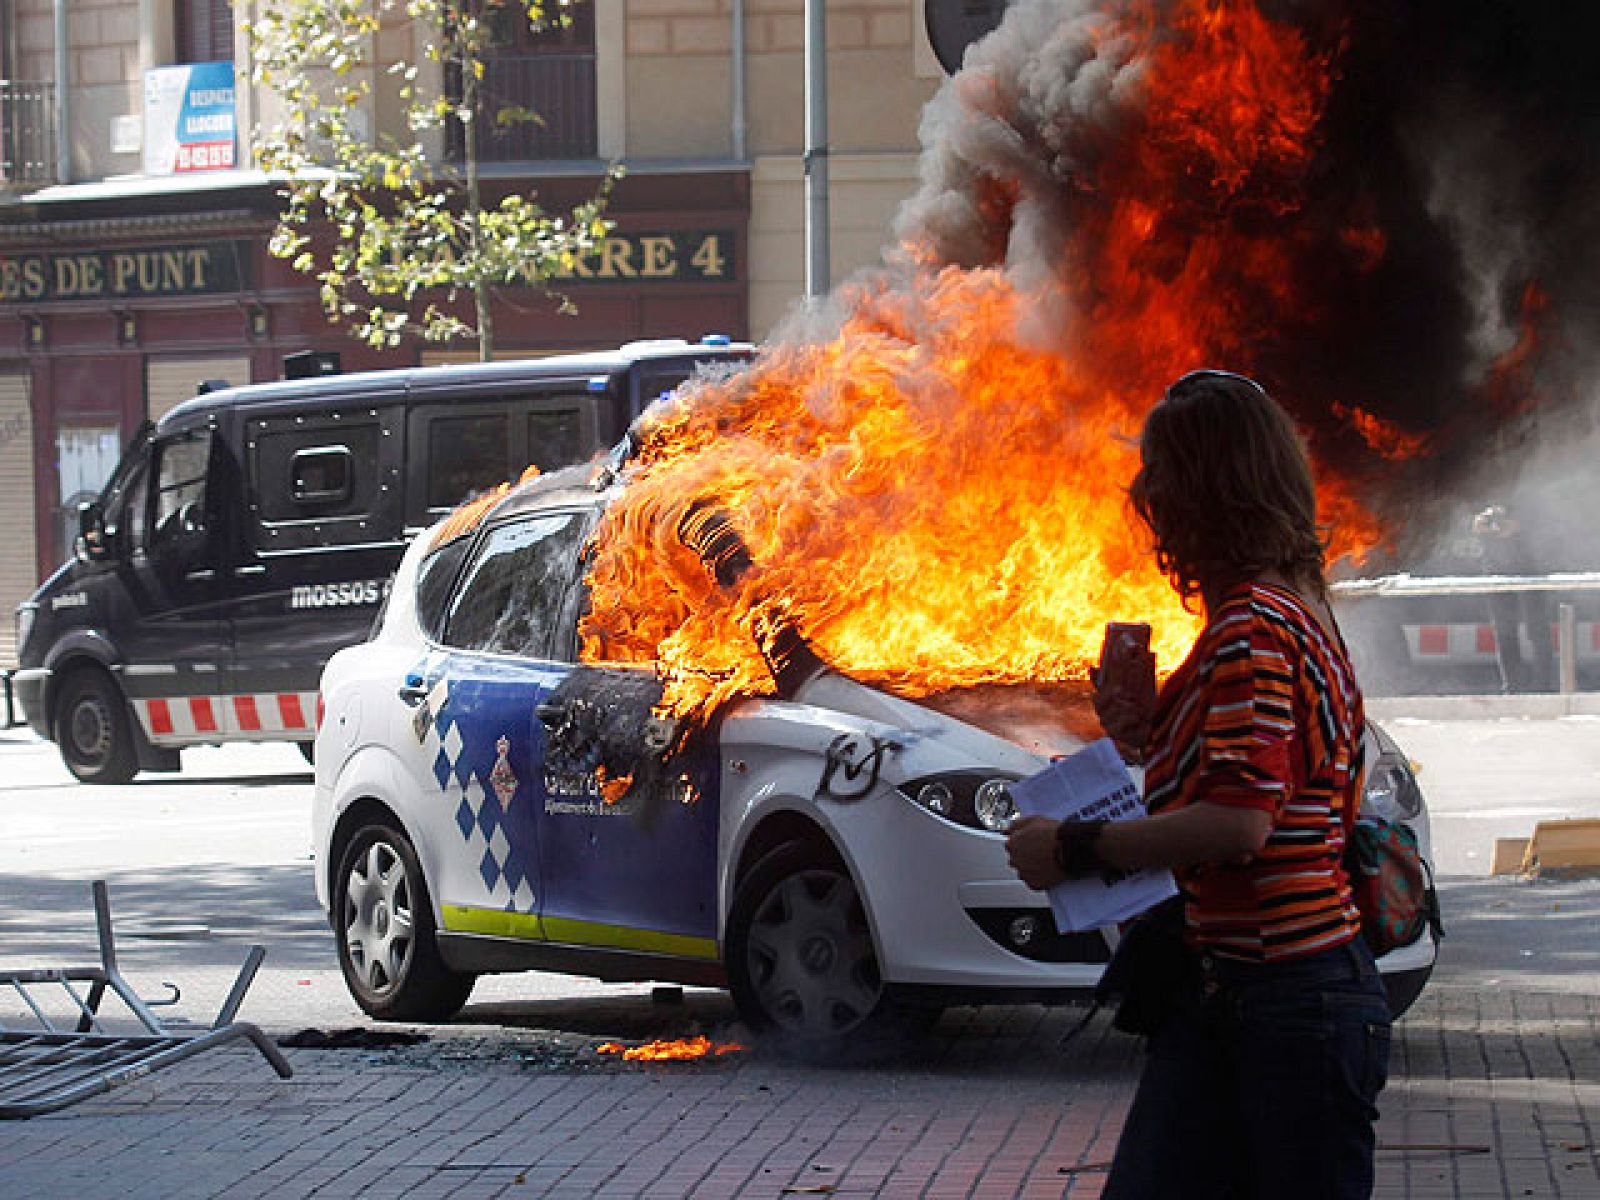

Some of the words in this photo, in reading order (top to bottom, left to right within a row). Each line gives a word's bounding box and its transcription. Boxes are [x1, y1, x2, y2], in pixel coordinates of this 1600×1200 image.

[0, 258, 46, 299] ES
[55, 254, 103, 297] DE
[112, 249, 210, 294] PUNT
[690, 234, 726, 277] 4
